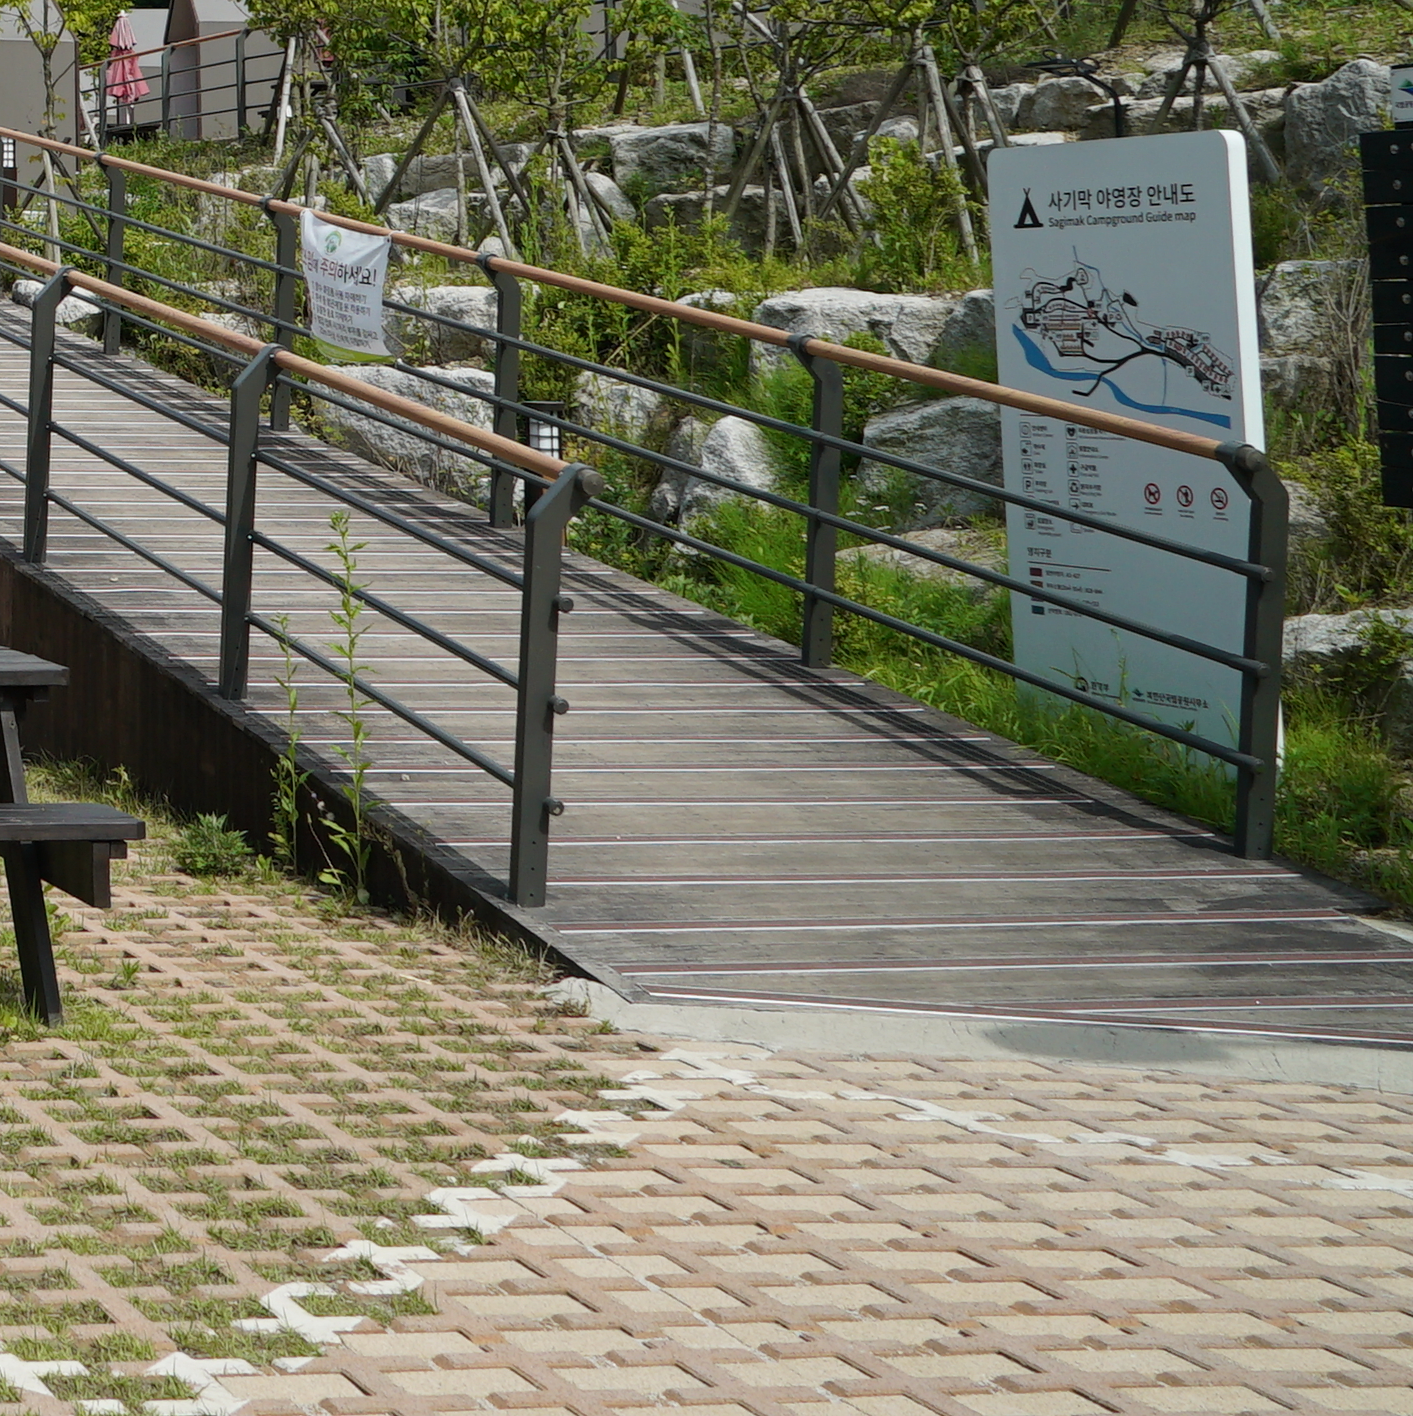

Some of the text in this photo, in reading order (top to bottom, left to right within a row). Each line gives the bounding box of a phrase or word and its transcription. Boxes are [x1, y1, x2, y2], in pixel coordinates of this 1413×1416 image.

[1048, 183, 1196, 212] 사기막 야영장 안내도
[1048, 211, 1196, 230] Sagimak Campground Guide map
[320, 257, 377, 287] 주의하세요!
